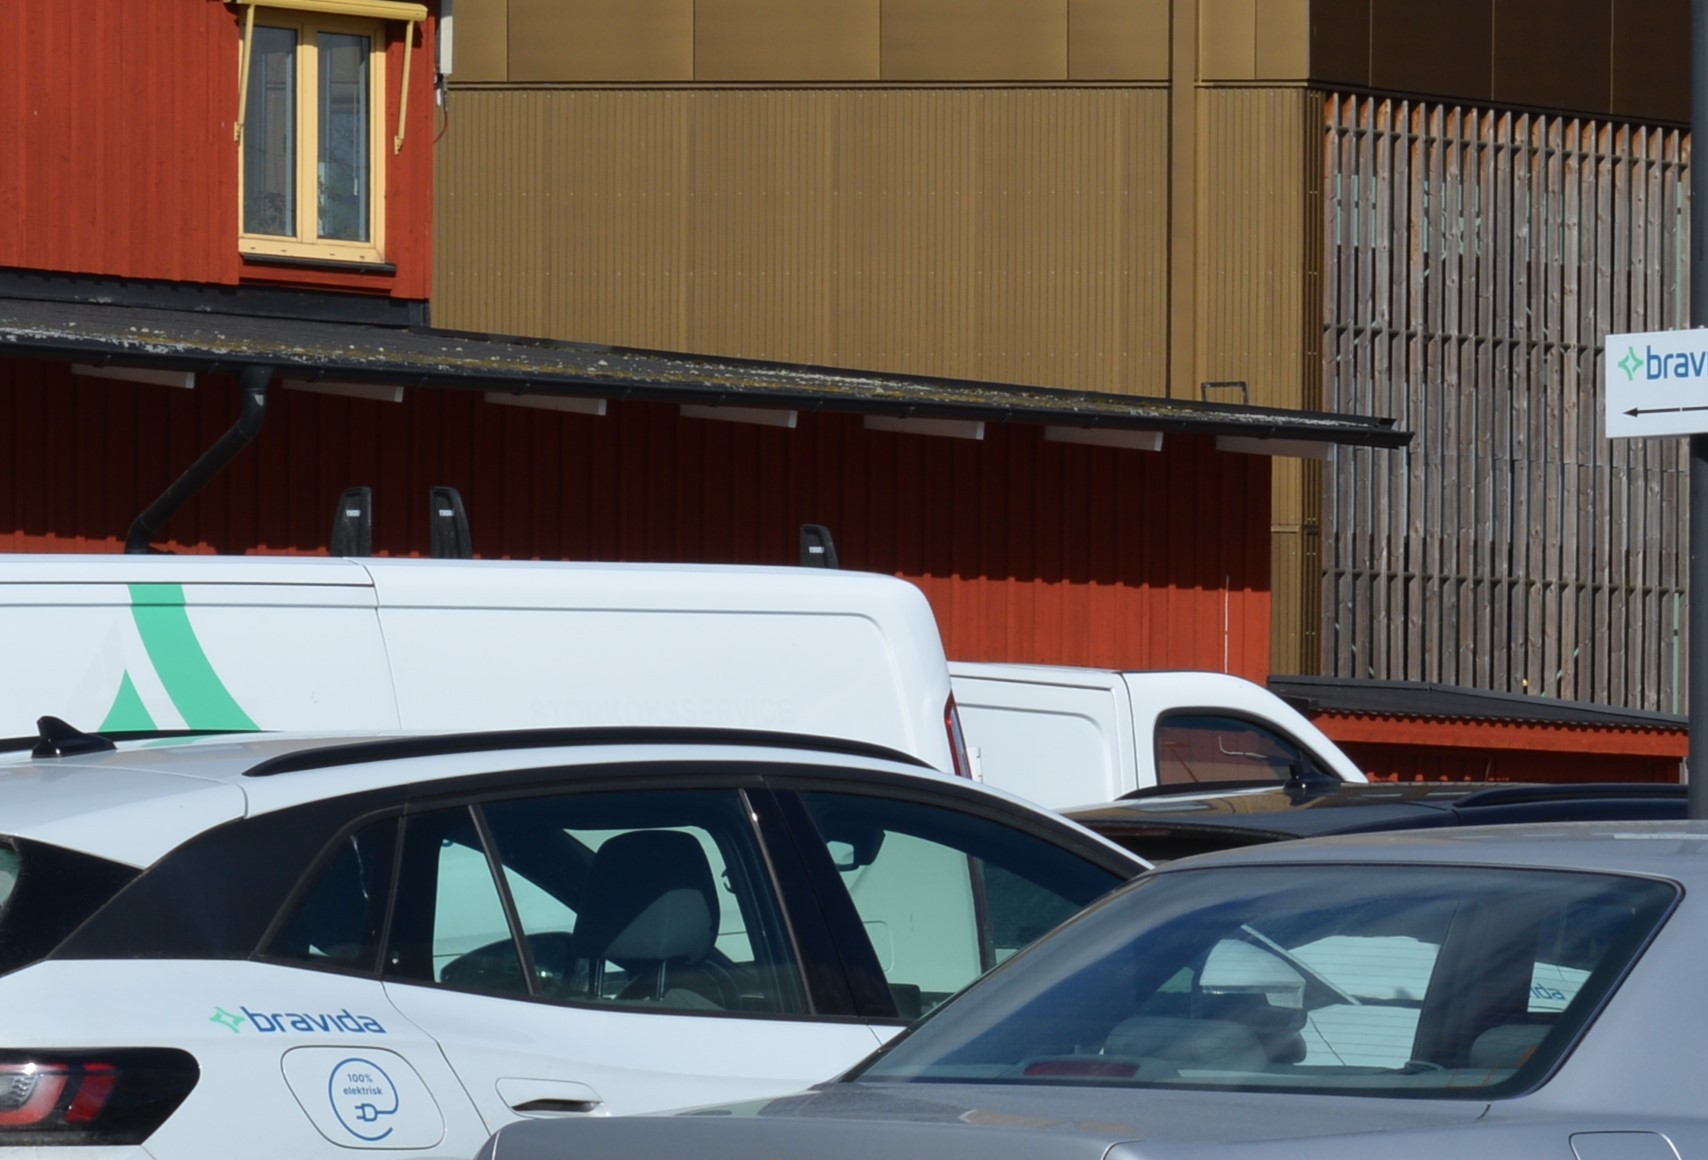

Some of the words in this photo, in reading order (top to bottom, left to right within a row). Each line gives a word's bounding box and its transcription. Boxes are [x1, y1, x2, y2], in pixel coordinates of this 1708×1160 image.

[240, 1006, 387, 1034] bravida
[346, 1073, 374, 1083] 100%
[342, 1086, 383, 1096] elektrisk
